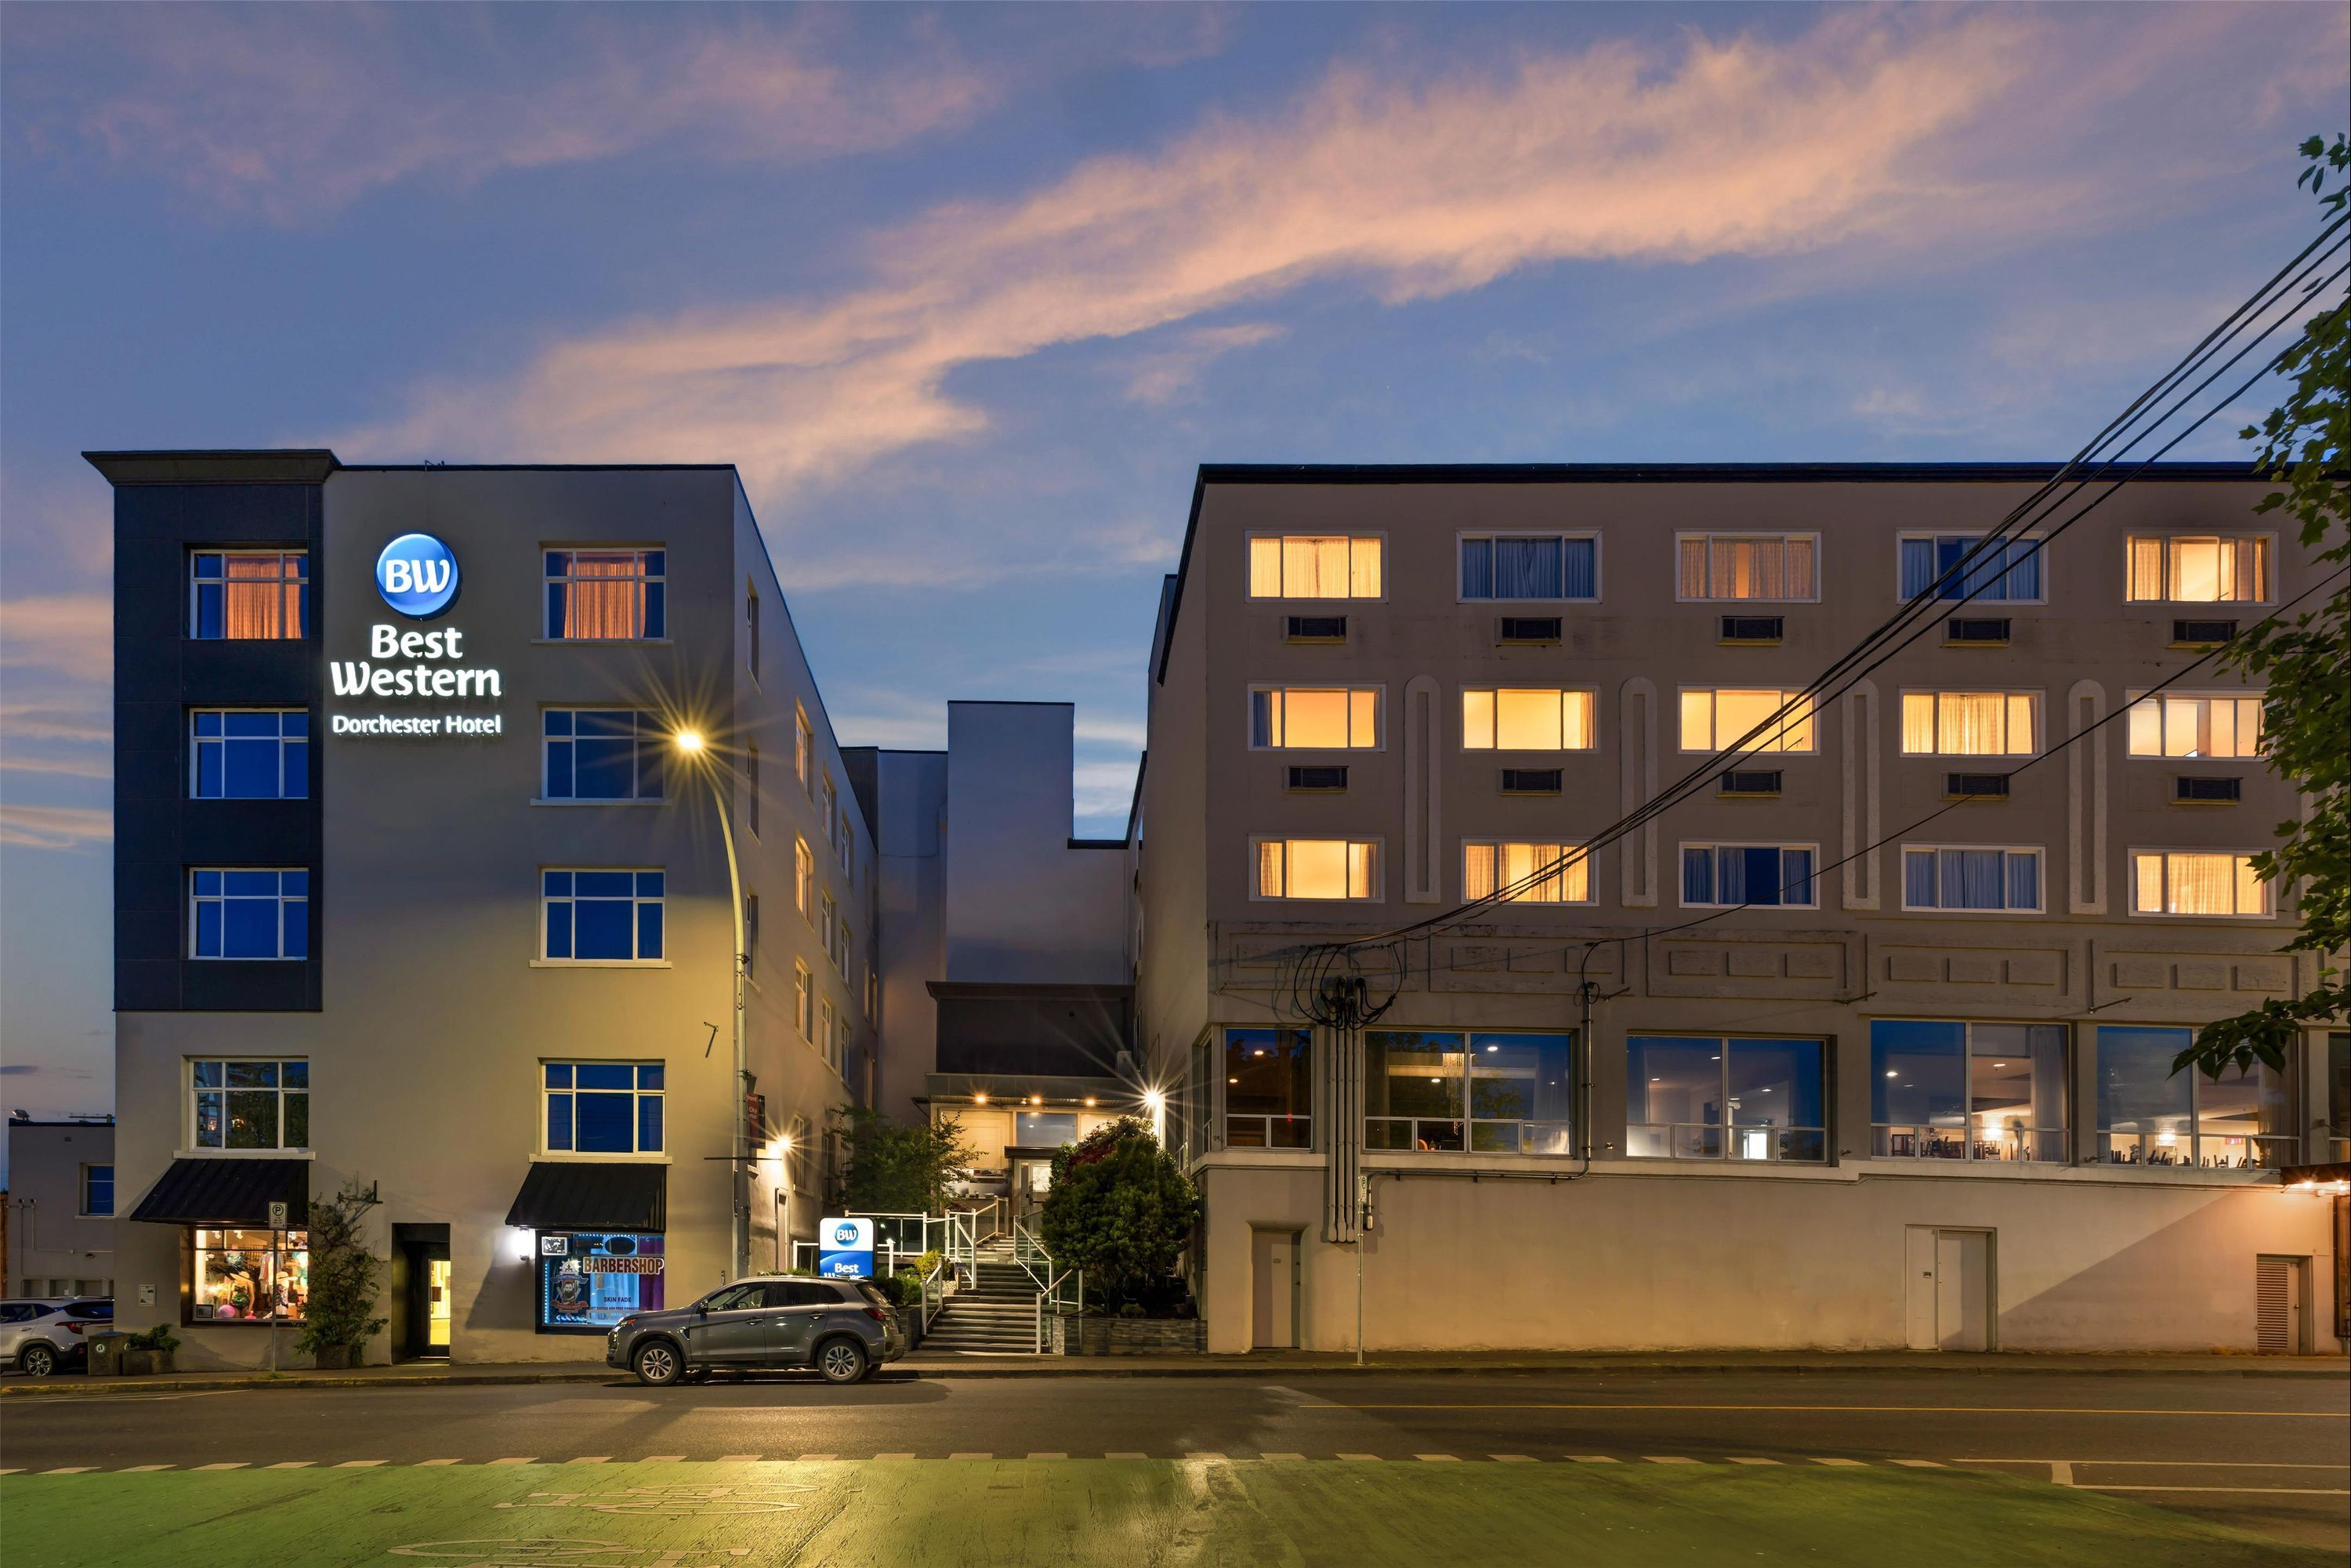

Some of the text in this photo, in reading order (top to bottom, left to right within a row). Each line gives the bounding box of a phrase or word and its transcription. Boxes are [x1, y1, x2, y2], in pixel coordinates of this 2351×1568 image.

[386, 559, 450, 593] BW
[371, 625, 463, 659] Best
[330, 661, 502, 697] Western
[332, 715, 502, 733] Dorchester Hotel
[836, 1229, 857, 1241] BW
[582, 1256, 665, 1275] BARBERSHOP
[835, 1262, 859, 1273] Best
